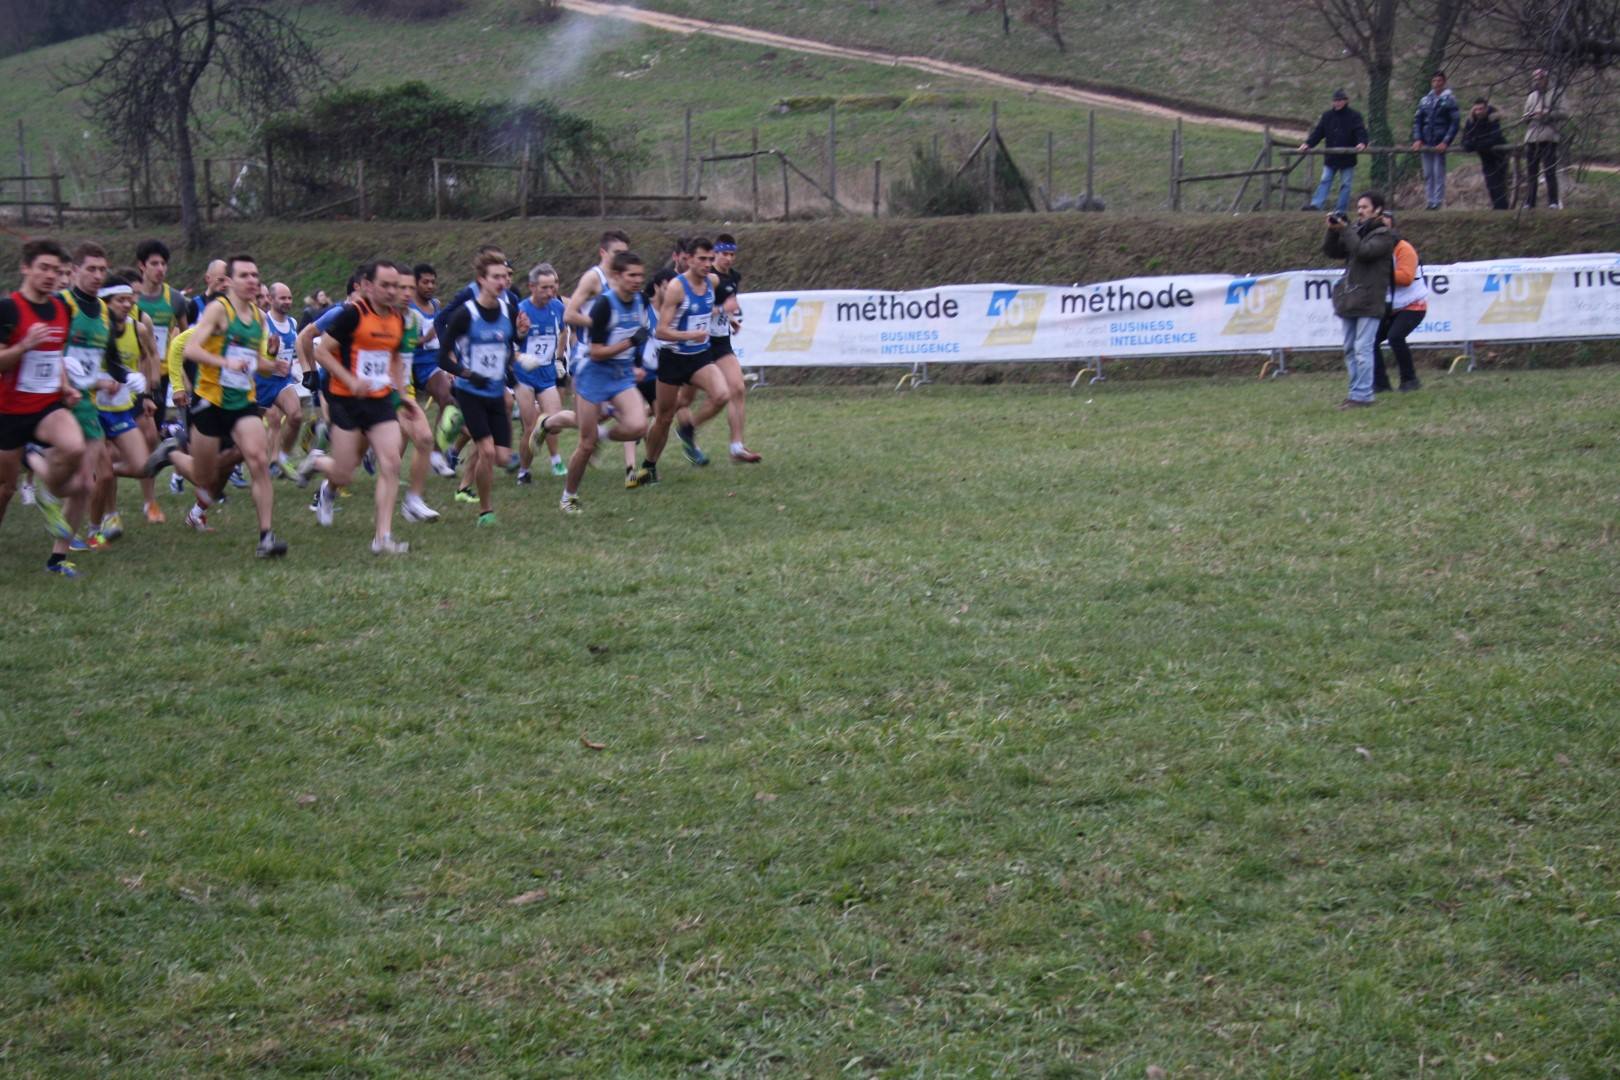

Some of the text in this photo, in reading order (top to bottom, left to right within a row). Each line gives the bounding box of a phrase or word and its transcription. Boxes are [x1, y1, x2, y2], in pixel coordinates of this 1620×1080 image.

[1060, 283, 1195, 314] méthode
[837, 292, 960, 321] méthode
[1110, 320, 1175, 333] BUSINESS
[880, 330, 940, 342] BUSINESS
[1110, 333, 1198, 347] INTELLIGENCE
[535, 343, 549, 355] 27
[881, 342, 960, 355] INTELLIGENCE
